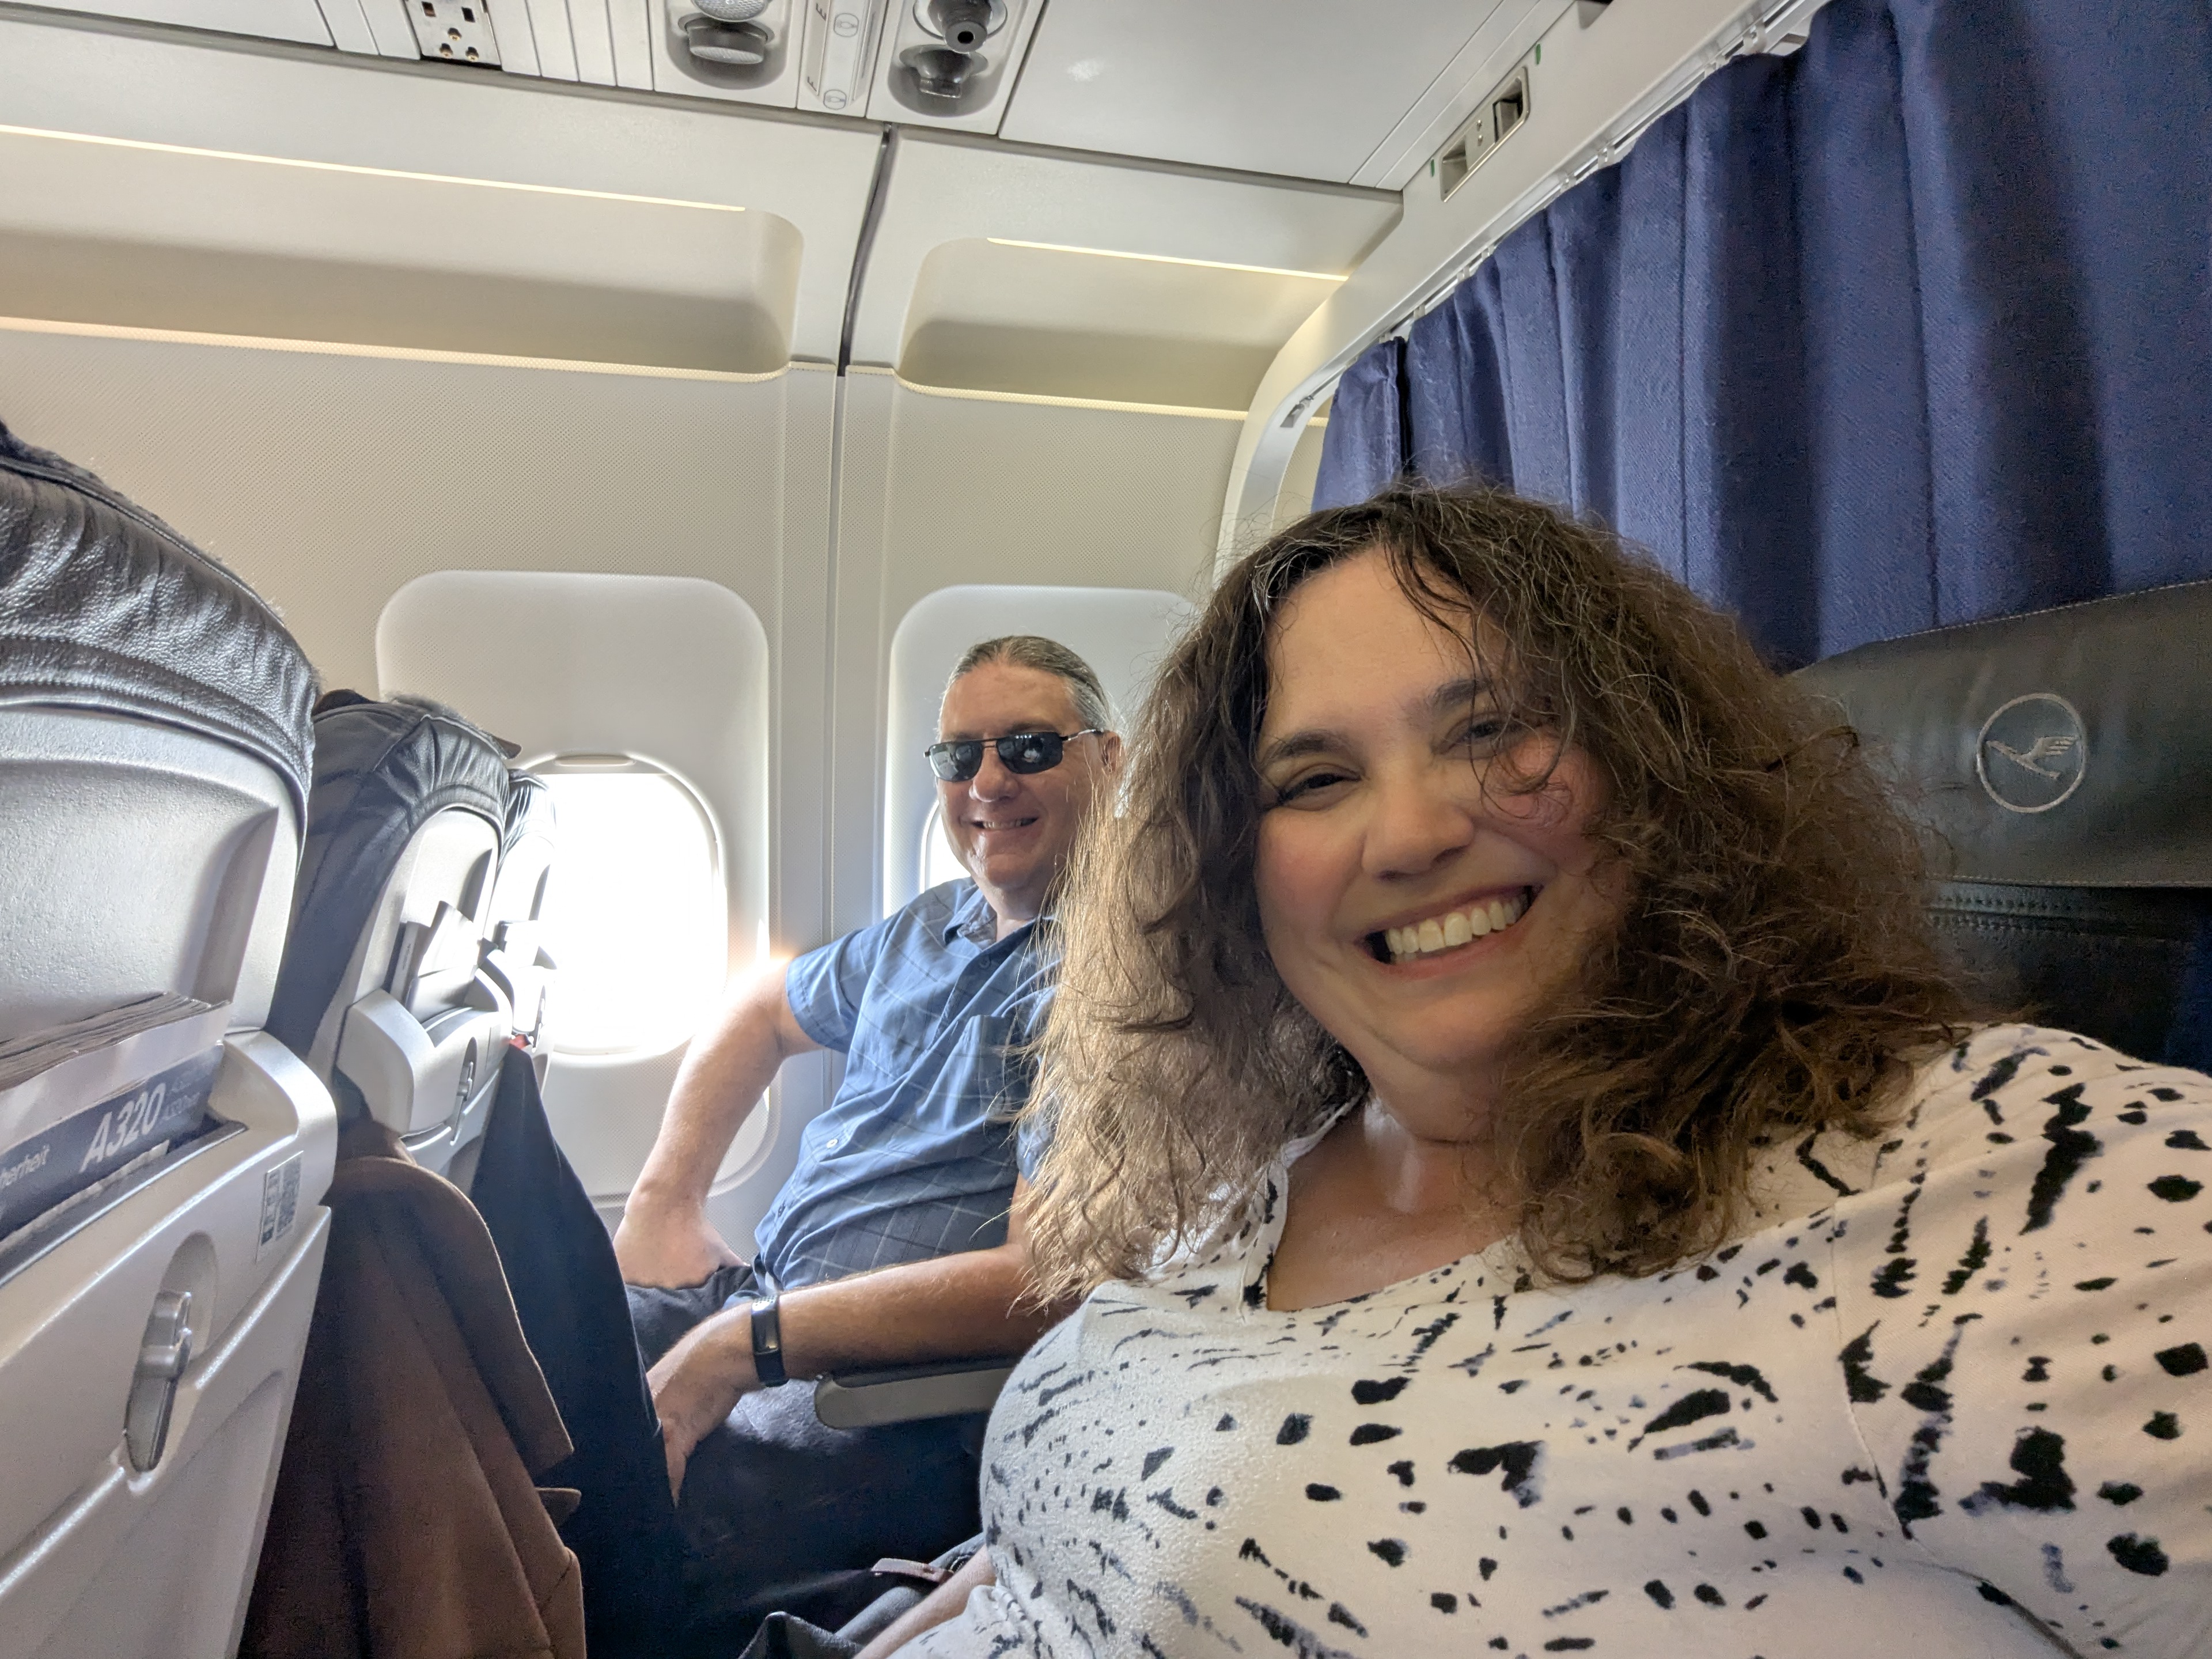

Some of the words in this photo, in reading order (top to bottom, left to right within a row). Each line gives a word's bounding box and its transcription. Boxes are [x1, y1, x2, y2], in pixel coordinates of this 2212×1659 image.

[816, 3, 827, 21] E
[807, 76, 817, 92] F
[79, 1082, 166, 1173] A320
